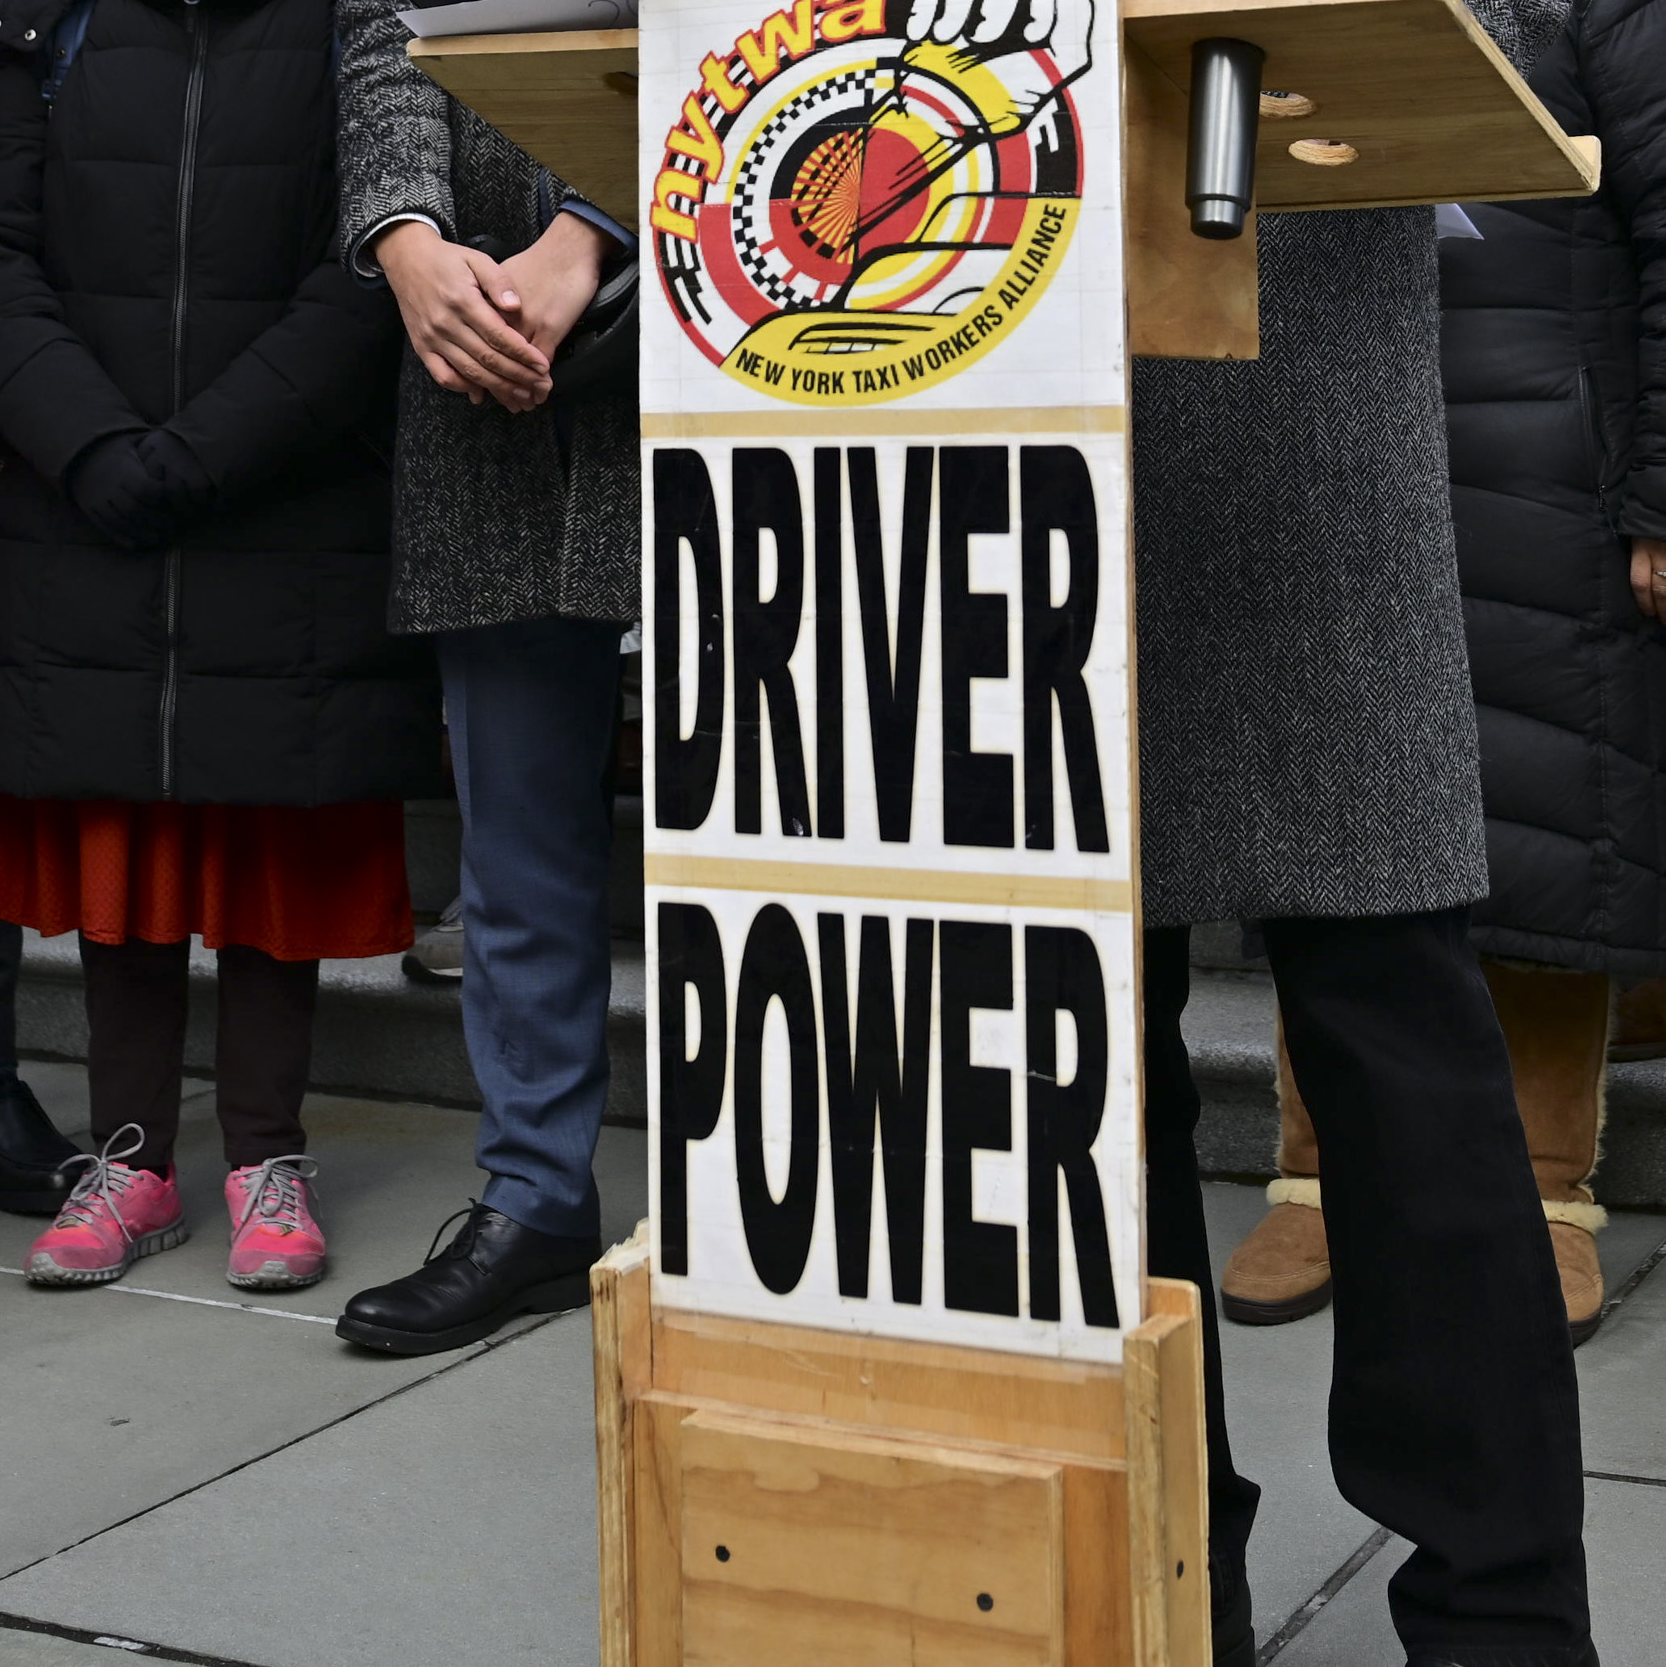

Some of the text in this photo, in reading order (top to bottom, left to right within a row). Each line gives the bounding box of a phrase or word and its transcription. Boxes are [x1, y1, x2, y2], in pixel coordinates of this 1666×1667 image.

[735, 204, 1067, 394] NEW YORK TAXI WORKERS ALLIANCE
[652, 441, 1112, 855] DRIVER
[657, 900, 1122, 1331] POWER
